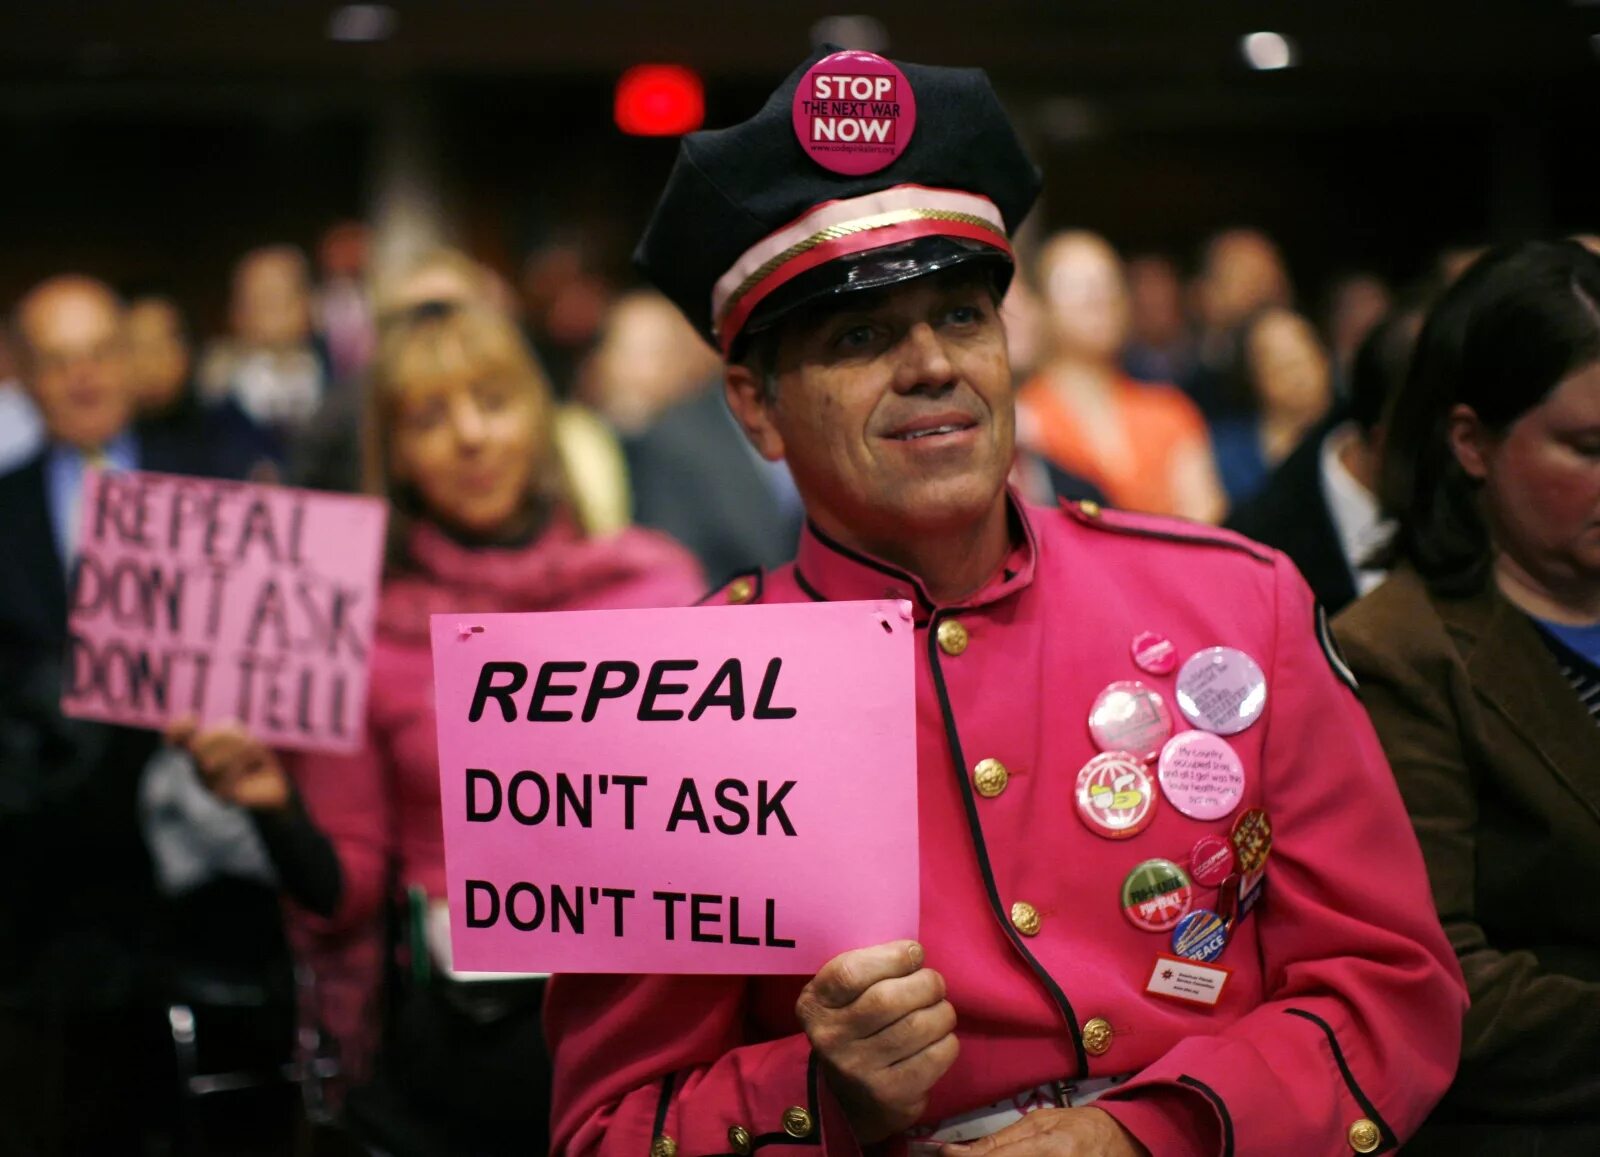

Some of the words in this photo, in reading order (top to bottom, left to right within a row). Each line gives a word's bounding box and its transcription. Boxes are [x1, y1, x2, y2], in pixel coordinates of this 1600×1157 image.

[802, 101, 828, 115] THE
[832, 102, 868, 117] NEXT
[870, 103, 900, 117] WAR
[815, 75, 892, 101] STOP
[814, 117, 892, 142] NOW
[93, 478, 308, 567] REPEAL
[247, 579, 368, 663] ASK
[236, 653, 350, 737] TELL
[468, 656, 797, 723] REPEAL
[465, 768, 648, 831] DON'T
[665, 777, 798, 837] ASK
[464, 879, 636, 938] DON'T
[652, 891, 796, 949] TELL
